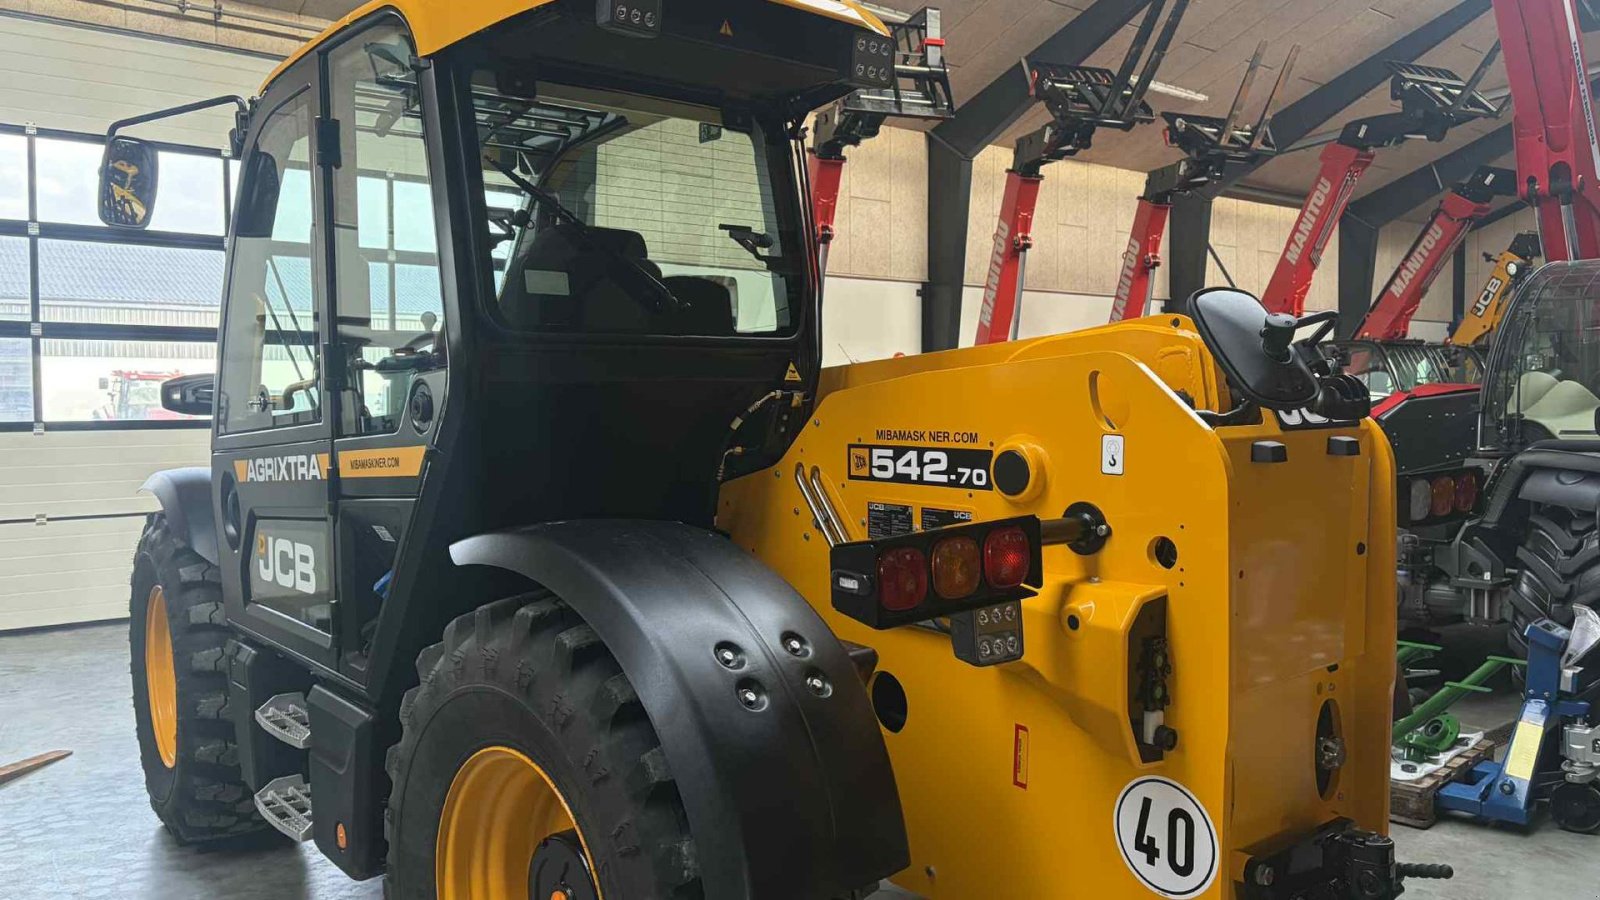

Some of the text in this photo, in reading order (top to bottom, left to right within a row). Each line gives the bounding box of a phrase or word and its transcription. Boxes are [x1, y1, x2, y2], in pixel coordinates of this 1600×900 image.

[1285, 177, 1331, 265] MANITOU
[981, 221, 1008, 327] MANITOU
[1390, 223, 1443, 298] MANITOU
[1474, 277, 1502, 316] JCB
[246, 454, 321, 482] AGRIXTRA
[350, 457, 400, 469] MIBAMASKINER.COM
[259, 536, 316, 595] JCB
[1134, 796, 1195, 878] 40
